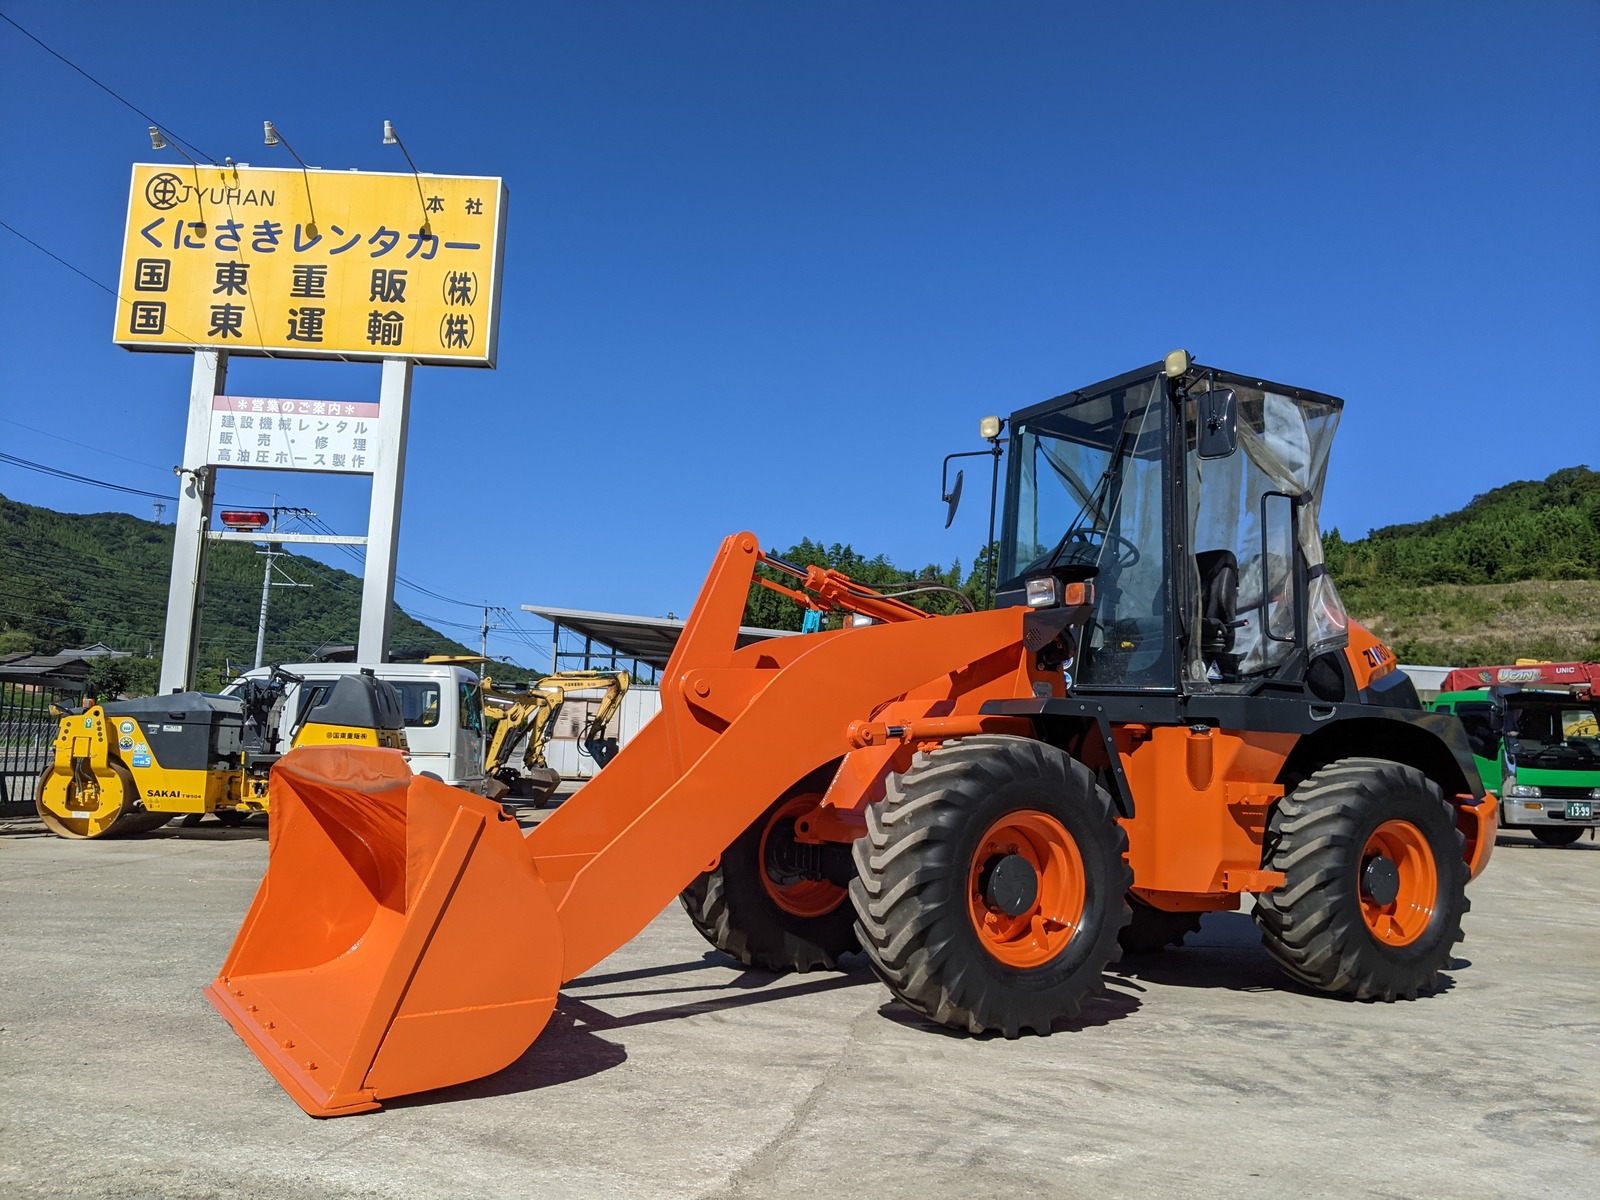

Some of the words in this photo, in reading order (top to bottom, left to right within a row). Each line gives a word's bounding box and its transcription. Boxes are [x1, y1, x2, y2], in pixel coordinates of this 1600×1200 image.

[176, 185, 275, 207] JYUHAN
[426, 196, 483, 215] 本社
[140, 217, 481, 260] くにさきレンタカー
[221, 415, 368, 435] 建設機械レンタル
[217, 448, 366, 468] 高油圧ホース製作
[1555, 666, 1576, 674] UNIC
[147, 790, 181, 798] SAKAI
